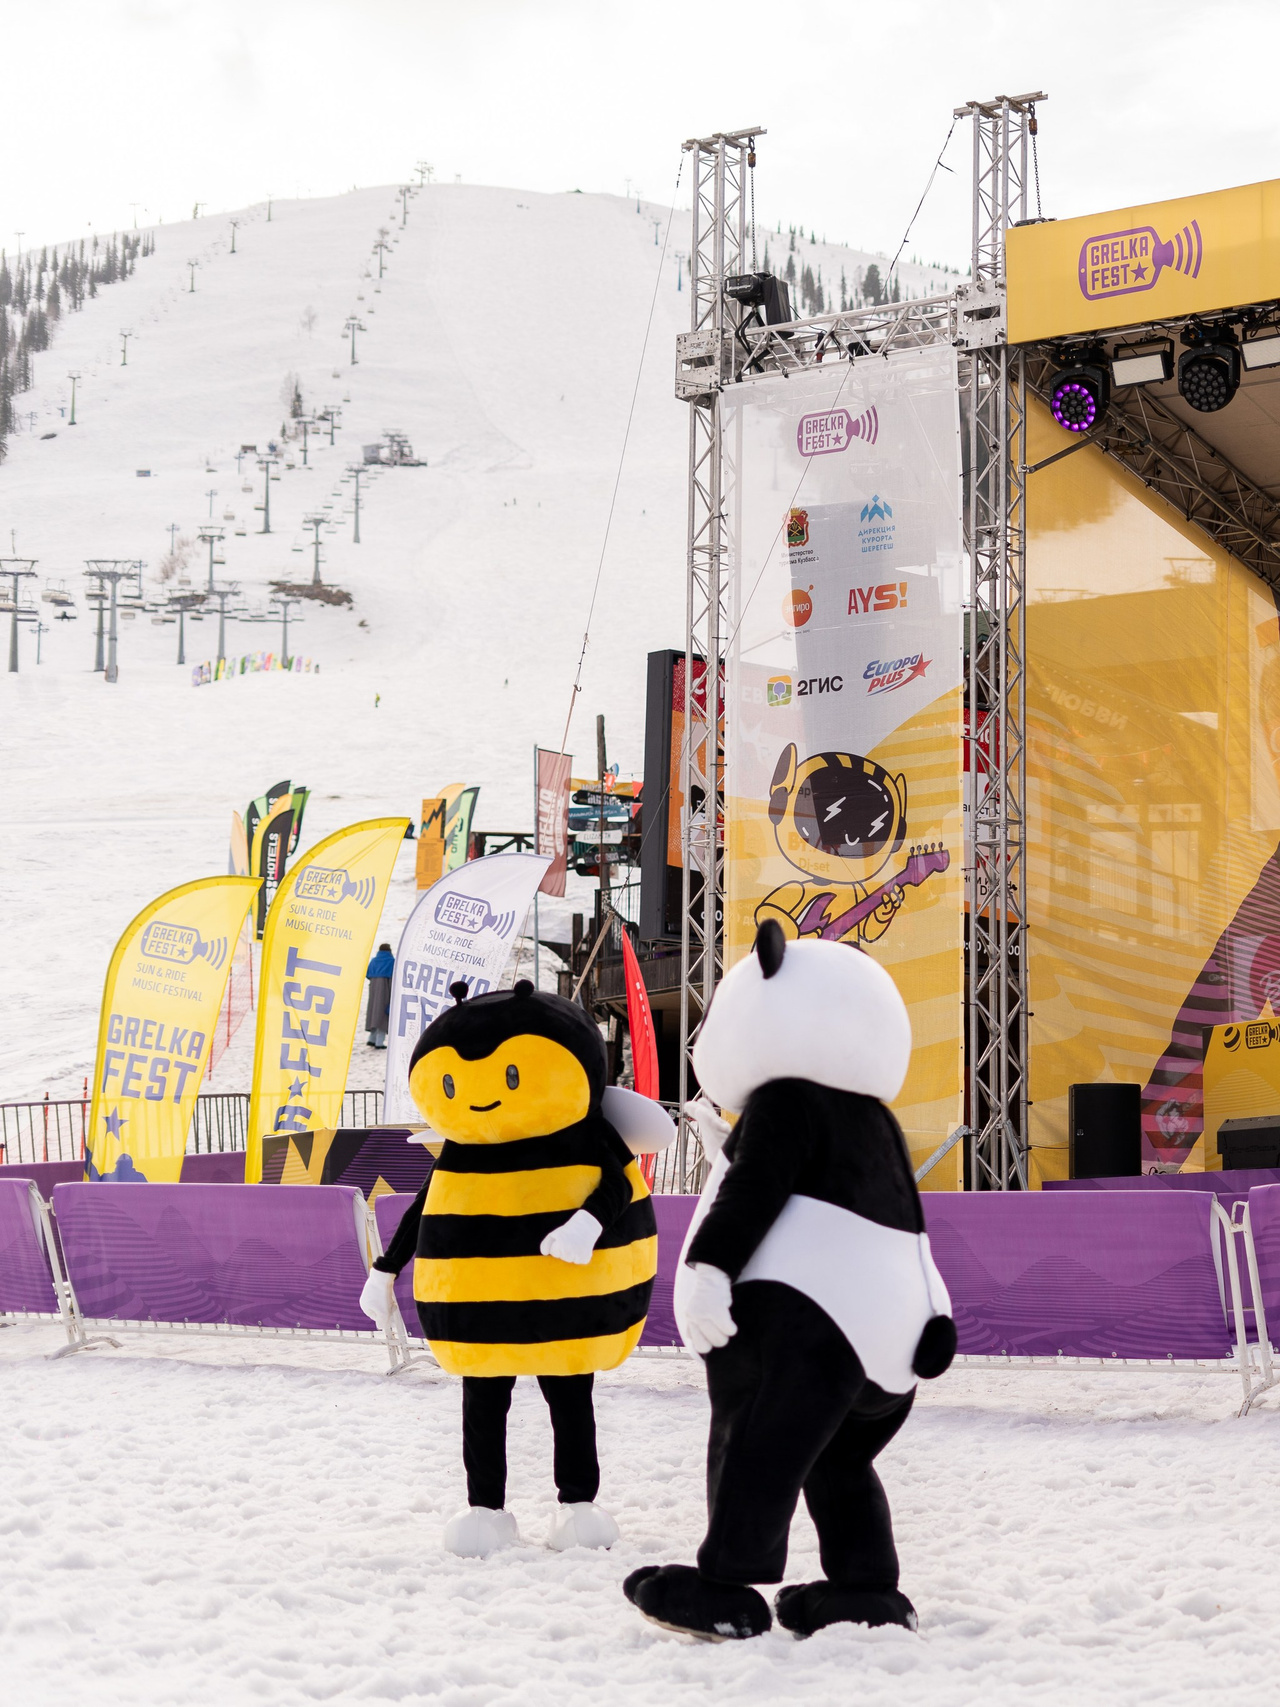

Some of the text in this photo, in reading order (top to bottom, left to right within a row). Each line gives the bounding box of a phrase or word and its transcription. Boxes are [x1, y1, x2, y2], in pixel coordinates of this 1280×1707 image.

[1091, 235, 1149, 266] GRELKA
[1091, 263, 1130, 291] FEST
[805, 415, 844, 435] GRELKA
[805, 433, 832, 450] FEST
[858, 525, 896, 537] ДИРЕКЦИЯ
[861, 535, 893, 544] КУРОРТА
[861, 543, 894, 553] ШЕРЕГЕШ
[847, 581, 908, 615] AYS!
[797, 675, 844, 697] 2ГИС
[266, 832, 279, 880] HOTELS
[306, 870, 343, 885] GRELKA
[301, 883, 327, 896] FEST
[289, 904, 337, 922] SUN & RIDE
[446, 896, 485, 917] GRELKA
[440, 909, 469, 926] FEST
[152, 926, 194, 946] GRELKA
[285, 918, 353, 941] MUSIC FESTIVAL
[147, 940, 177, 956] FEST
[427, 930, 474, 950] SUN & RIDE
[422, 943, 486, 968] MUSIC FESTIVAL
[136, 962, 187, 983] SUN & RIDE
[131, 977, 203, 1002] MUSIC FESTIVAL
[280, 946, 342, 1078] FEST
[106, 1013, 206, 1060] GRELKA
[1249, 1036, 1262, 1046] FEST
[102, 1049, 198, 1105] FEST
